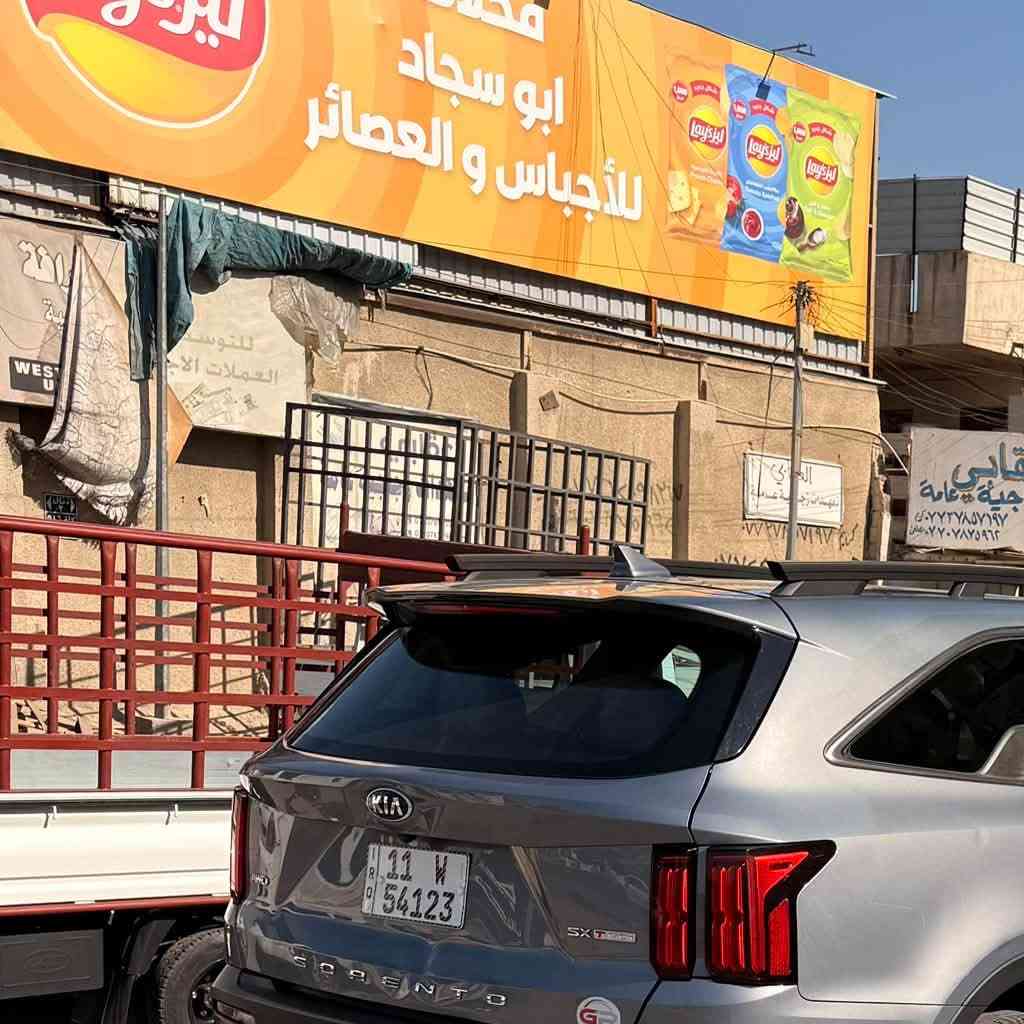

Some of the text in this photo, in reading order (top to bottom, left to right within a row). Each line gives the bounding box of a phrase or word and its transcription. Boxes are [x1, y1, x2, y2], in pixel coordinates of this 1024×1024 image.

[398, 32, 564, 137] ابو سجاد
[304, 82, 453, 171] العصائر
[462, 144, 487, 196] و
[14, 360, 60, 377] WES
[919, 480, 960, 503] عامة
[371, 795, 404, 816] KIA
[567, 926, 591, 938] SX
[293, 953, 507, 1007] SORENTO
